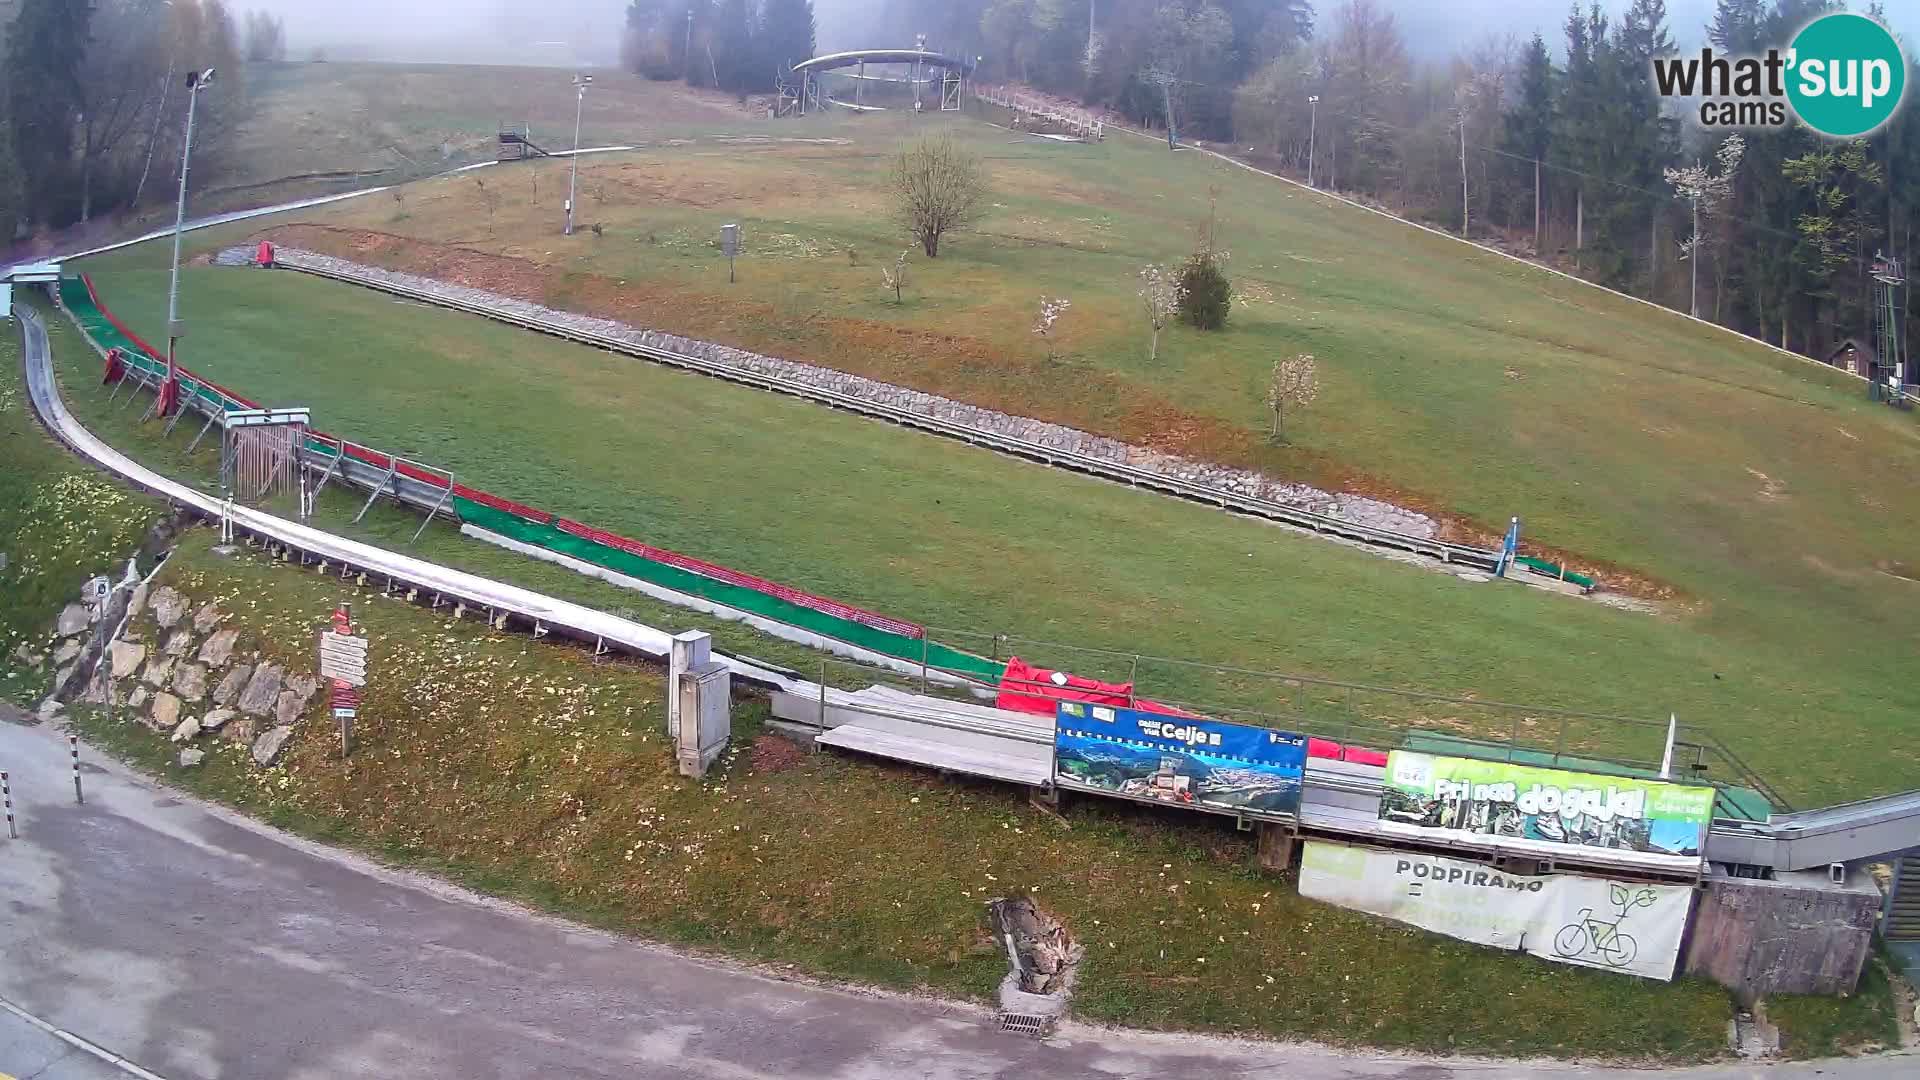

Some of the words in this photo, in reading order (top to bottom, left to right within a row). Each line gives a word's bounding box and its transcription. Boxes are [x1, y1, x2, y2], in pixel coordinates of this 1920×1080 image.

[1161, 723, 1207, 745] Celje
[1434, 778, 1471, 801] Pri
[1474, 781, 1516, 802] nas
[1517, 783, 1646, 822] dogaja!
[1396, 859, 1544, 892] PODPIRAMO
